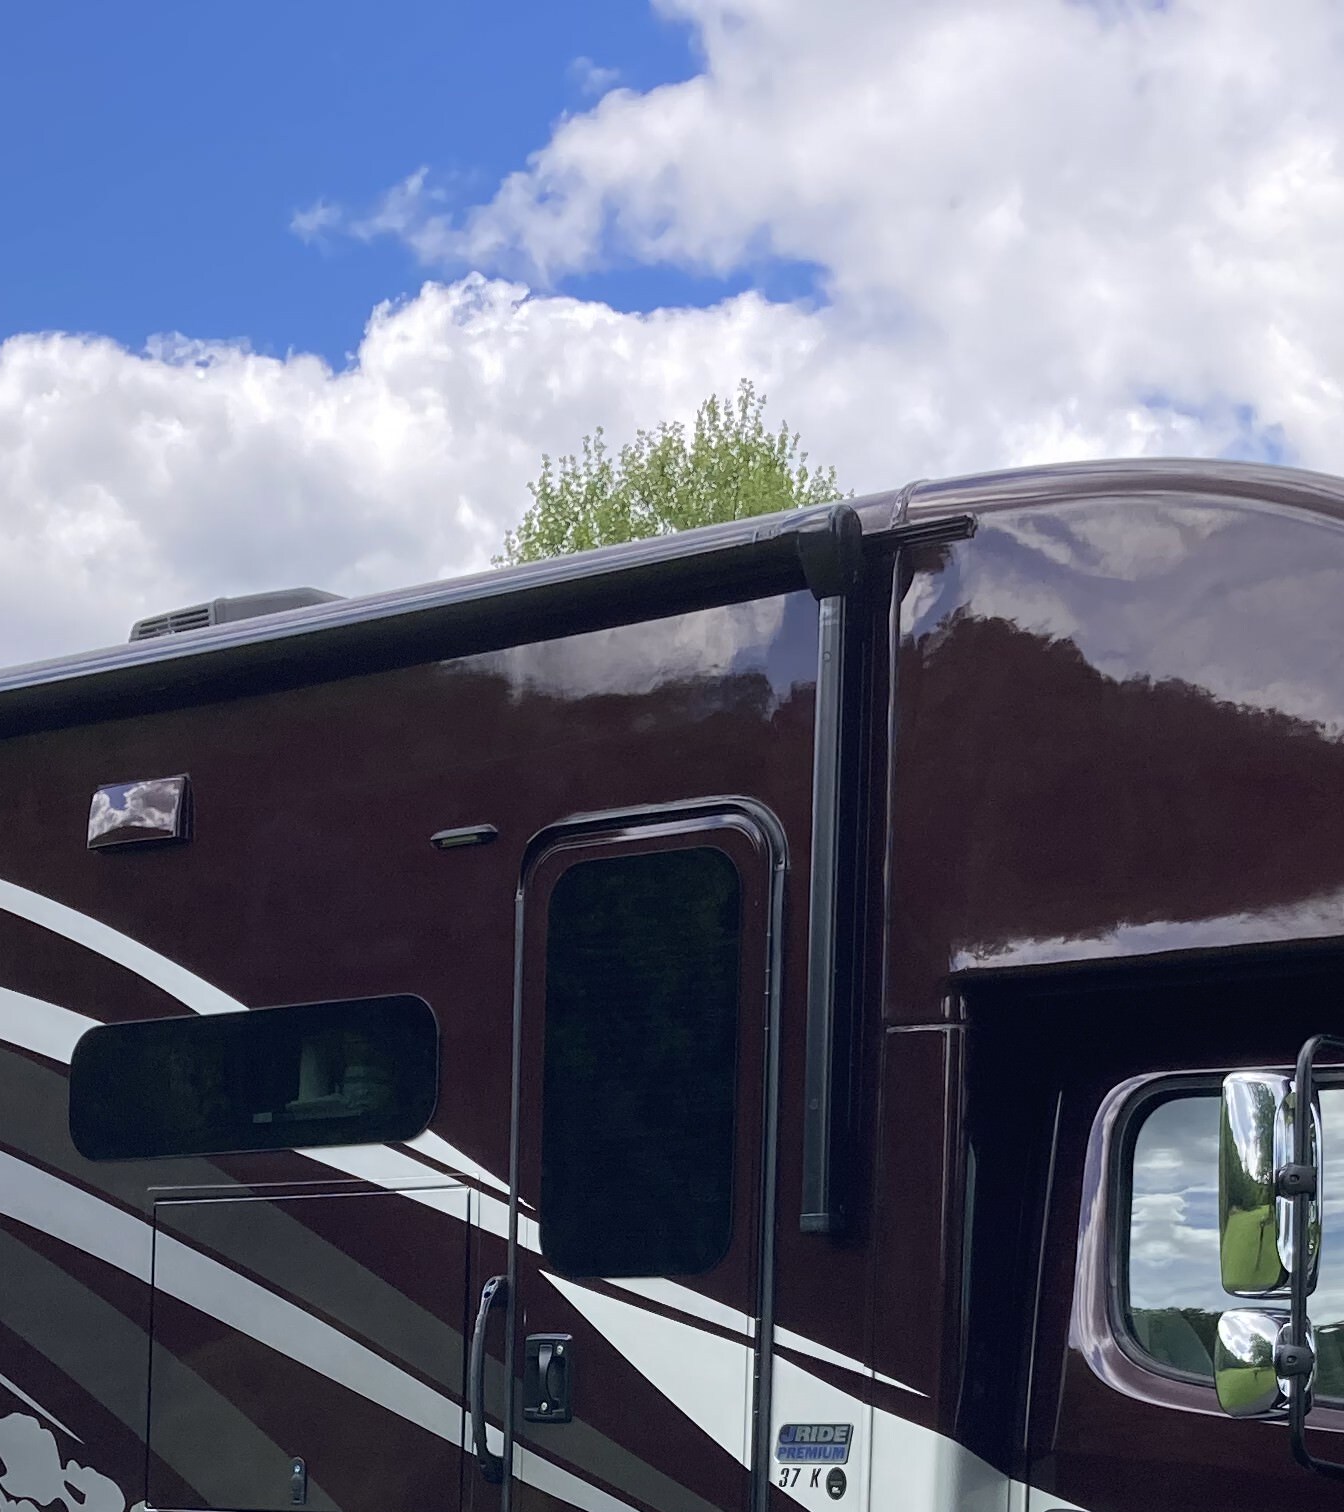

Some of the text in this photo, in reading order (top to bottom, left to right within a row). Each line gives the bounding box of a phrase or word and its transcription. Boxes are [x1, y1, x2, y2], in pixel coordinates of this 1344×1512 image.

[778, 1425, 850, 1444] JRIDE
[777, 1446, 846, 1460] PREMIUM
[778, 1467, 802, 1488] 37
[809, 1467, 822, 1488] K
